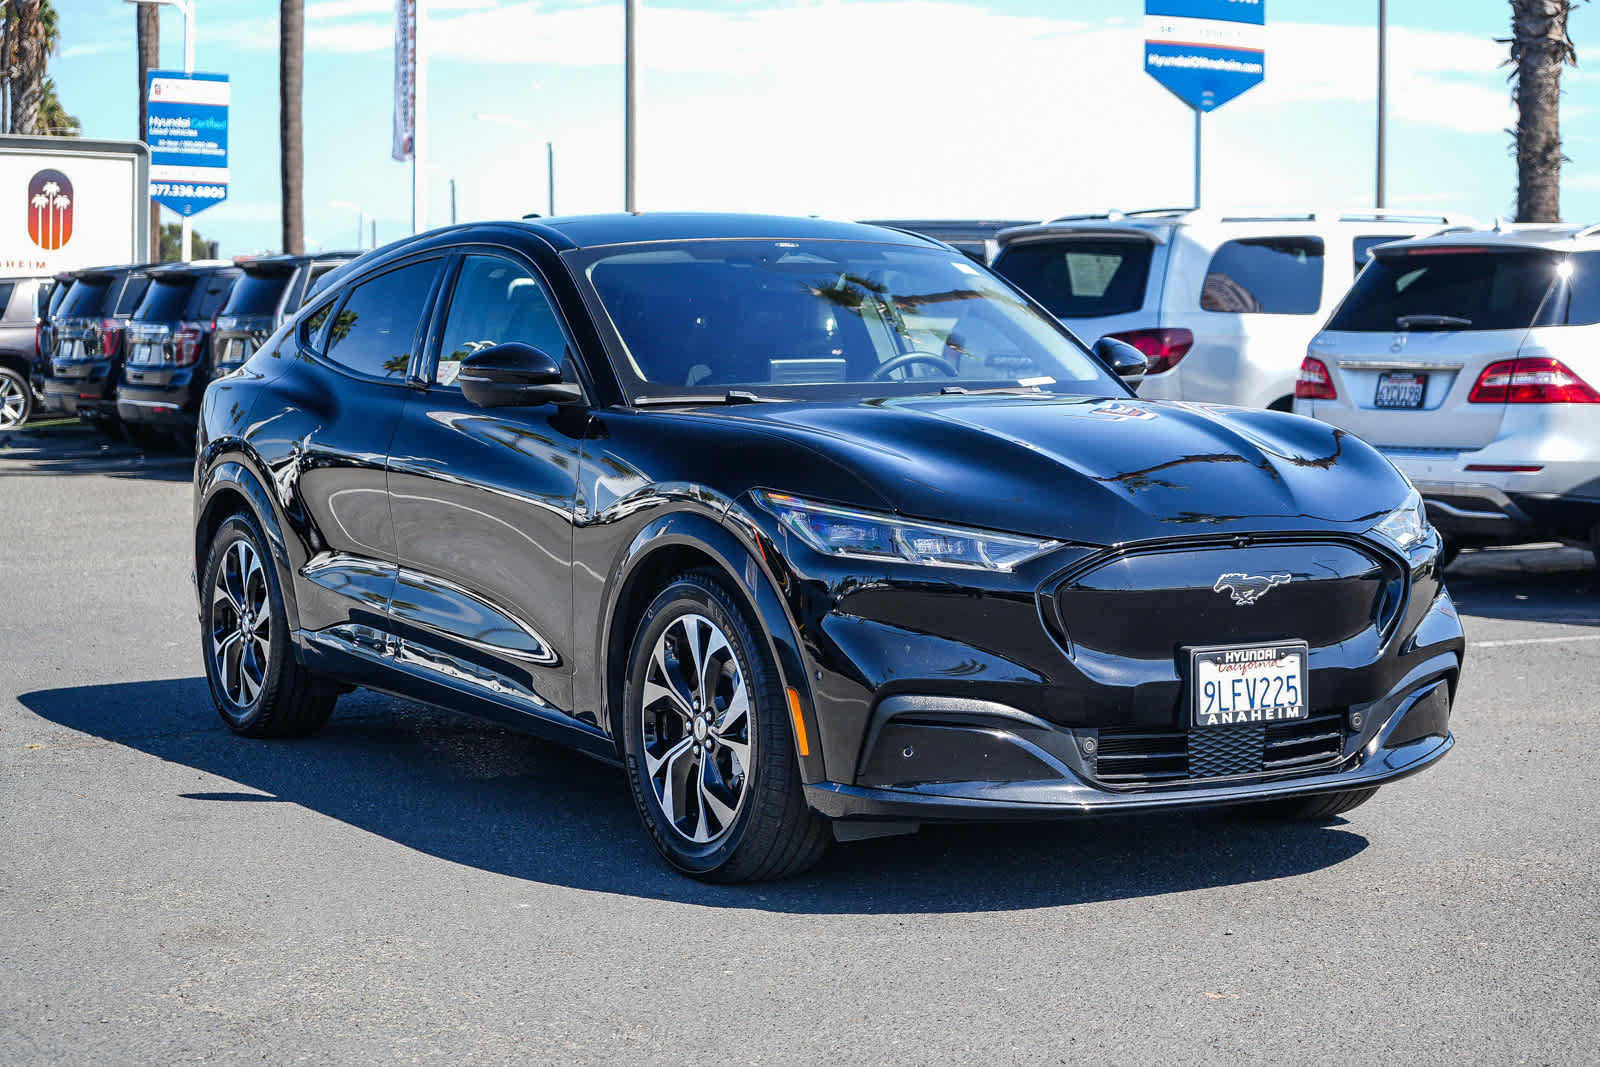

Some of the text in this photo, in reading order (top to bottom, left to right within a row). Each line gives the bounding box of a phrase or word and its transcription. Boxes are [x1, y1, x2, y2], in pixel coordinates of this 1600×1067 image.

[149, 116, 190, 129] Hyundai
[1225, 648, 1277, 663] HYUNDAI
[1217, 659, 1286, 676] California
[1203, 675, 1299, 713] 9LFV225
[1207, 707, 1299, 725] ANAHEIM
